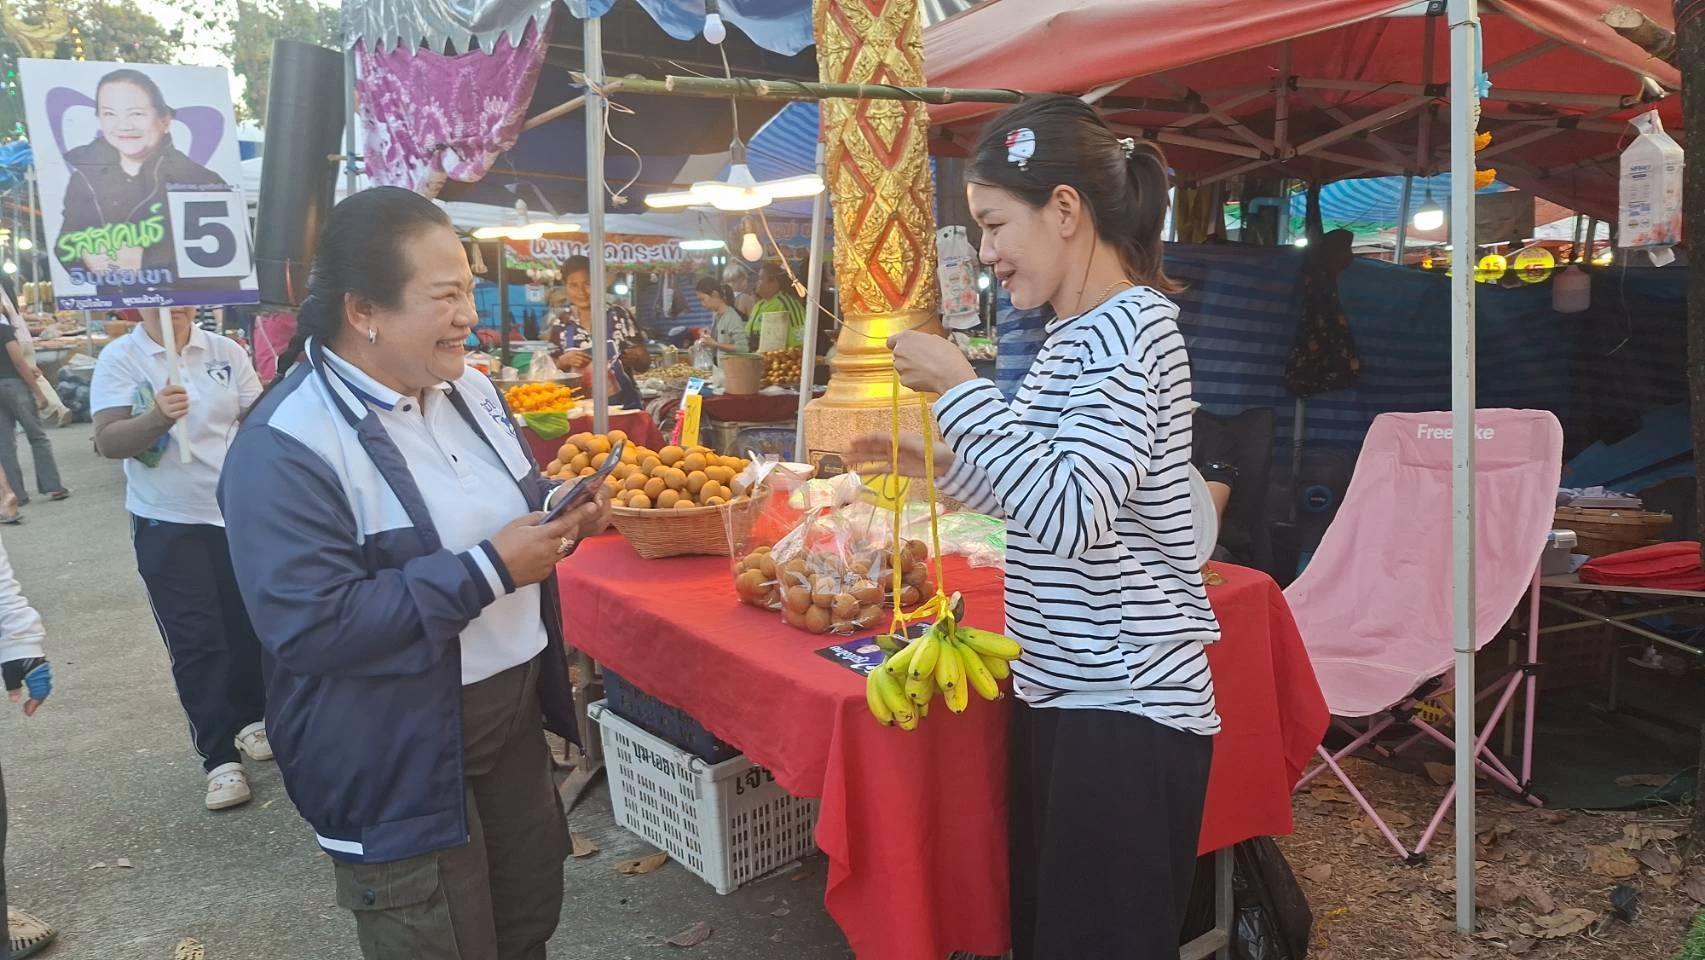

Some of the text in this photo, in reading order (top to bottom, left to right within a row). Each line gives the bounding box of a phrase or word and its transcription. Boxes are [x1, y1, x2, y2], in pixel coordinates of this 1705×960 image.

[58, 203, 165, 262] รสสุคนธ์
[184, 201, 237, 268] 5
[1417, 423, 1494, 440] Freeke
